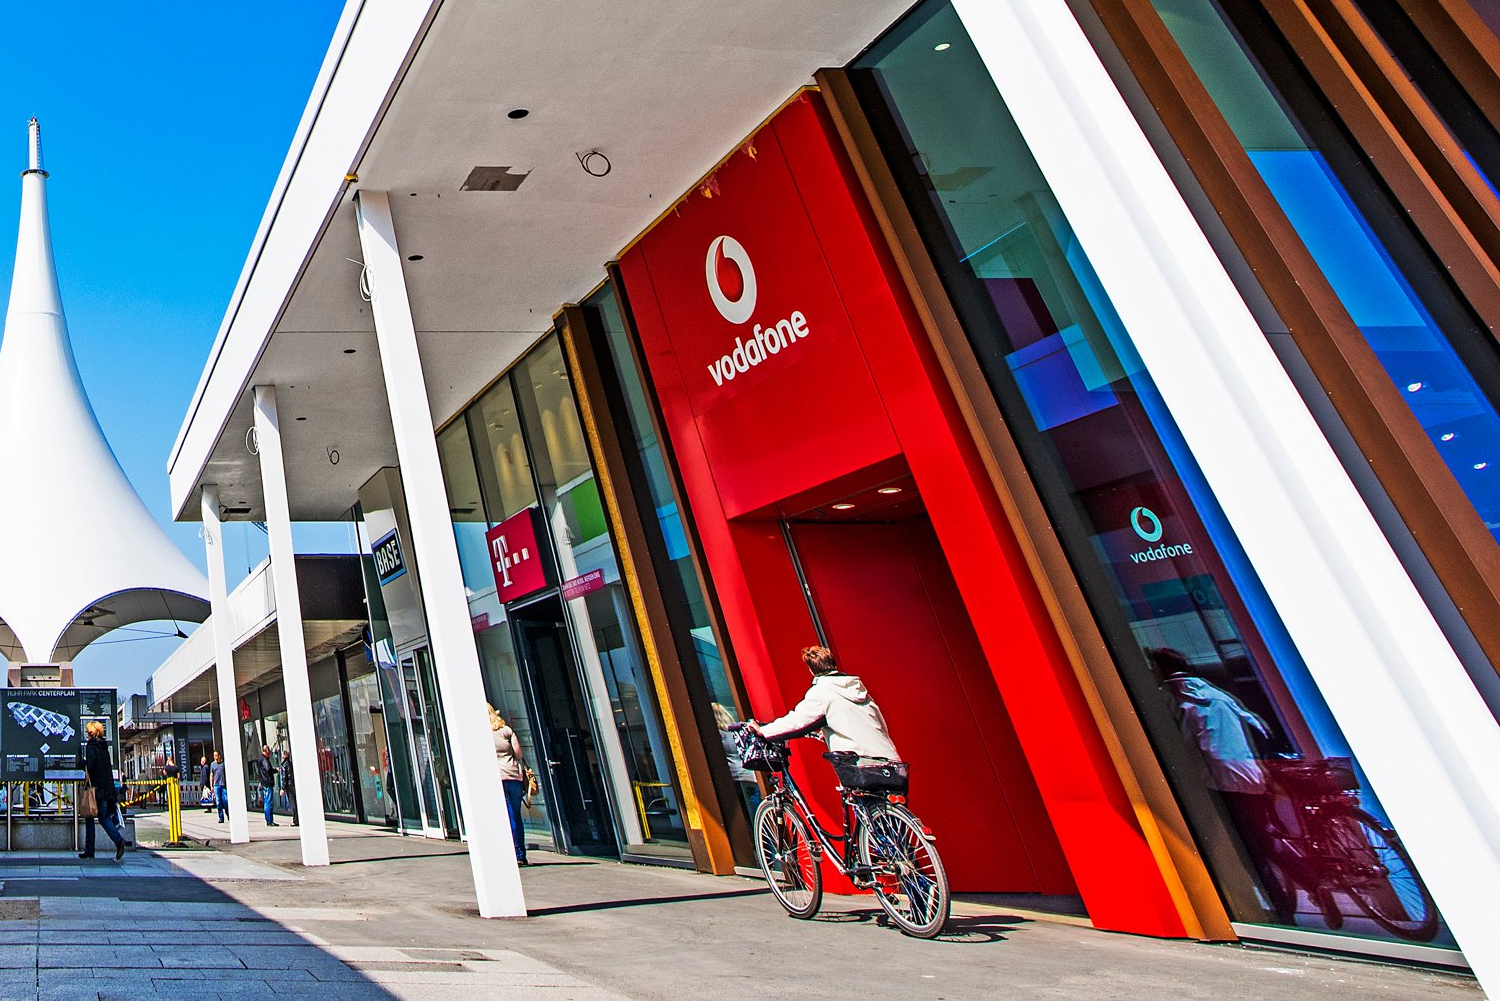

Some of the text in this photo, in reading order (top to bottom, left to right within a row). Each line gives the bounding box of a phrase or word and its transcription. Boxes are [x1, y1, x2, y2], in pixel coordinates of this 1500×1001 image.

[707, 310, 810, 387] vodafone
[375, 539, 401, 576] BASE
[1129, 542, 1193, 564] vodafone
